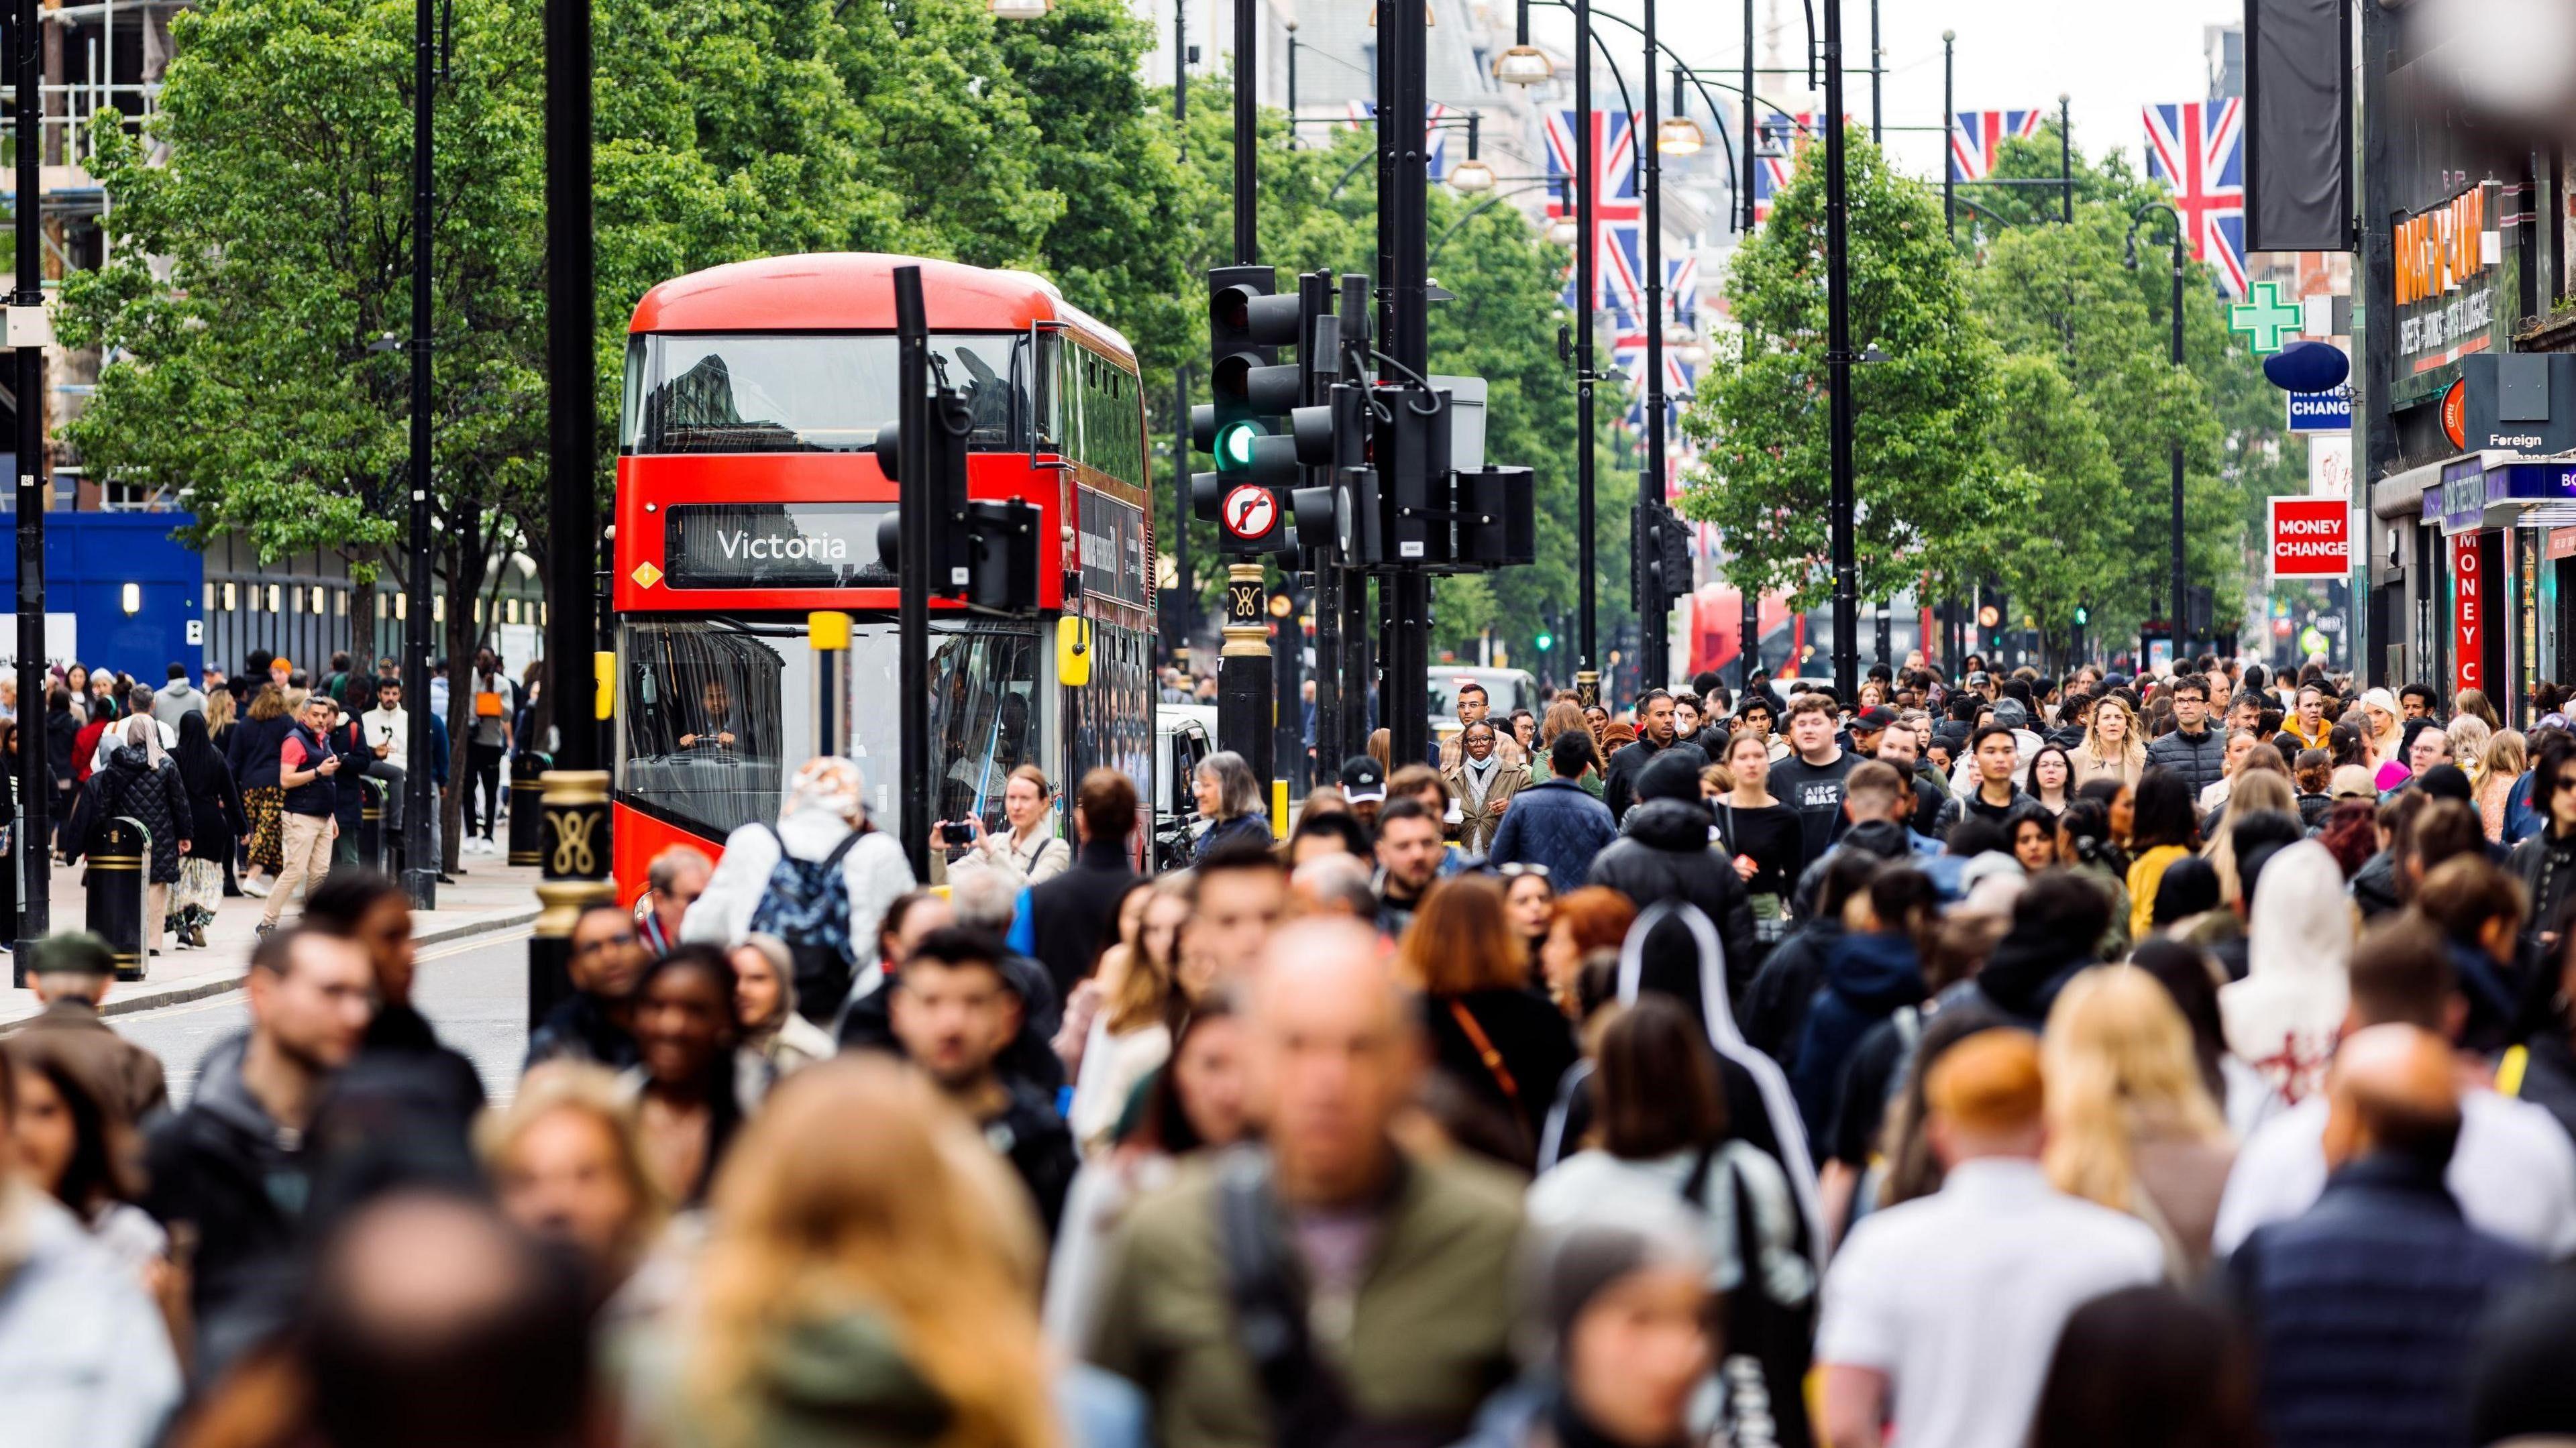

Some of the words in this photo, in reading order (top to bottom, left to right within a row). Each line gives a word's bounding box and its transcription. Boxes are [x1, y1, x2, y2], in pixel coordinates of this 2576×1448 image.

[2292, 401, 2351, 415] CHANG
[2447, 402, 2455, 428] COFFEE
[2490, 434, 2542, 448] Foreign
[2279, 519, 2342, 535] MONEY
[717, 530, 847, 559] Victoria
[2275, 541, 2347, 557] CHANGE
[2459, 535, 2477, 645] MONEY
[1805, 785, 1825, 796] AIR
[1805, 793, 1838, 805] MAX
